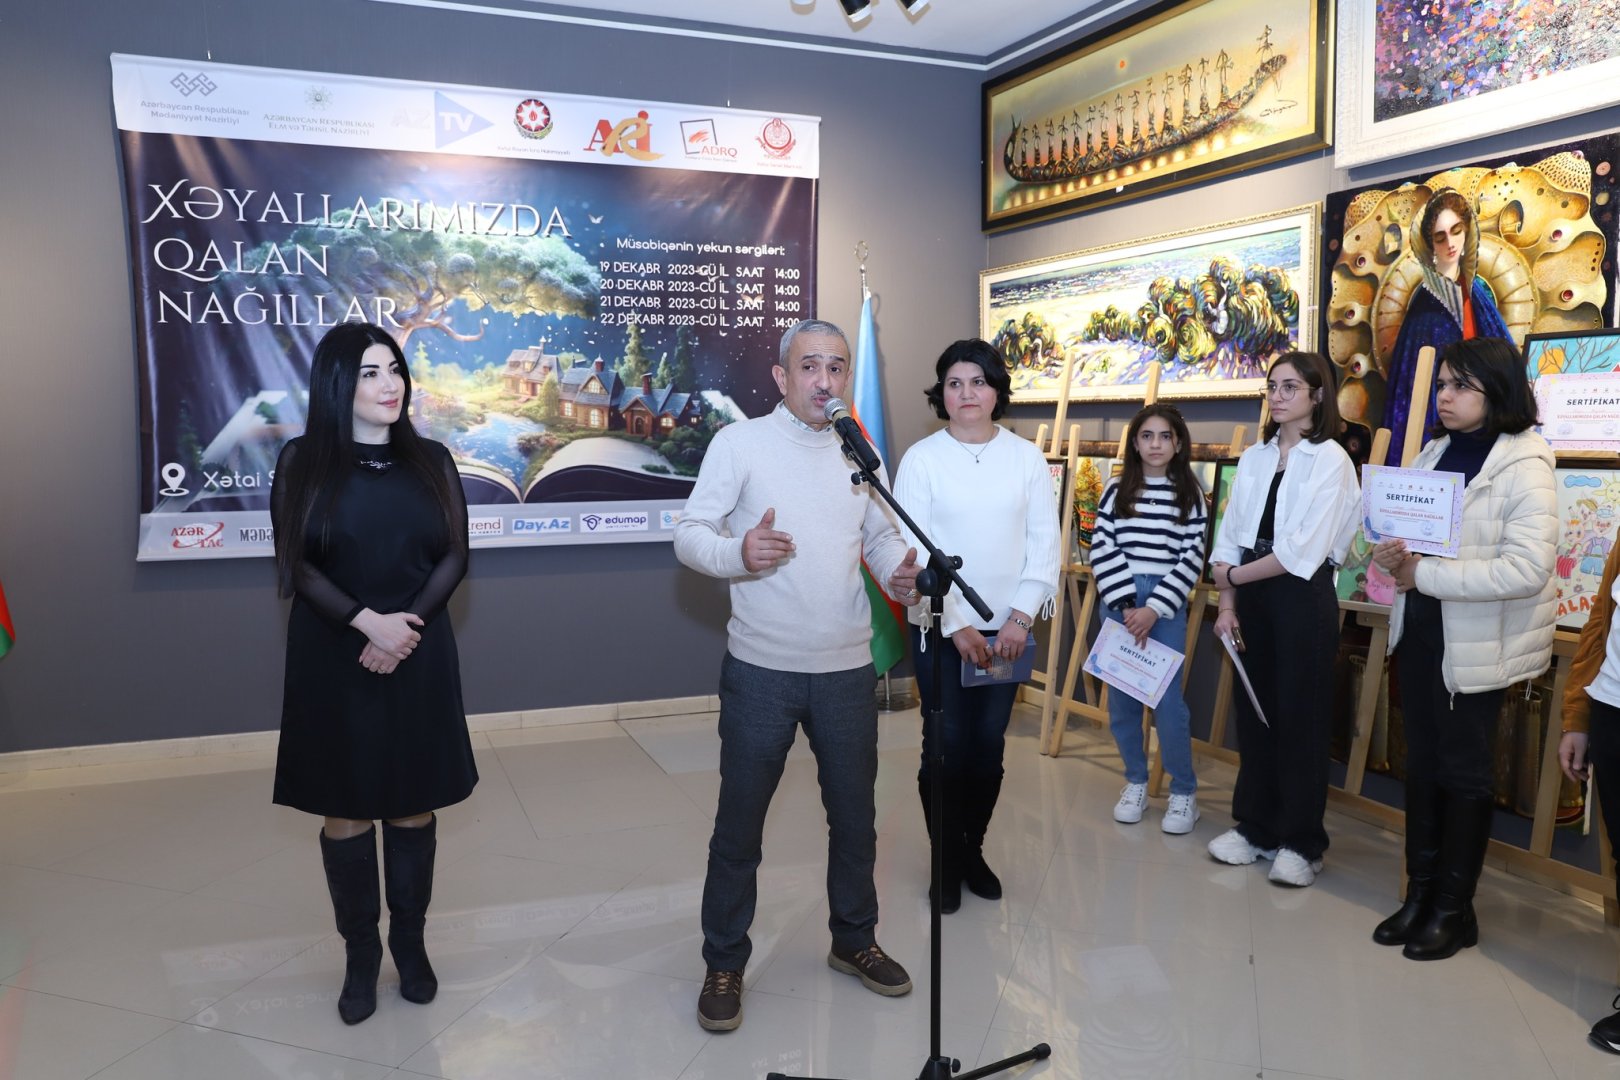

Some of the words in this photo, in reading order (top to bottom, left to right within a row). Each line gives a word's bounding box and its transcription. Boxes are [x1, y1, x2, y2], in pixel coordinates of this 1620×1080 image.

[439, 111, 475, 133] TV
[141, 179, 572, 238] XƏYALLARIMIZDA
[616, 237, 694, 253] Müsabiqənin
[696, 241, 733, 255] yekun
[153, 238, 329, 283] QALAN
[600, 261, 610, 273] 19
[613, 261, 661, 274] DEKABR
[719, 263, 730, 278] İL
[735, 266, 765, 279] SAAT
[774, 267, 801, 281] 14:00
[600, 278, 614, 290] 20
[617, 279, 665, 292] DEKABR
[719, 279, 730, 295] İL
[735, 283, 765, 295] SAAT
[774, 284, 801, 297] 14:00
[157, 286, 402, 327] NAĞILLAR
[600, 295, 612, 308] 21
[614, 295, 662, 309] DEKABR
[719, 296, 730, 311] İL
[736, 299, 765, 312] SAAT
[774, 300, 801, 313] 14:00
[600, 312, 615, 325] 22
[617, 313, 665, 326] DEKABR
[719, 313, 730, 327] İL
[736, 315, 765, 328] SAAT
[1566, 396, 1620, 406] SERTİFİKAT
[203, 470, 261, 489] Xətai
[1385, 492, 1436, 505] SERTİFİKAT
[513, 518, 570, 532] Day.Az
[605, 515, 647, 526] edumap
[170, 526, 205, 538] AZƏR
[240, 528, 274, 542] MƏDƏ
[1119, 645, 1157, 668] SERTİFİKAT
